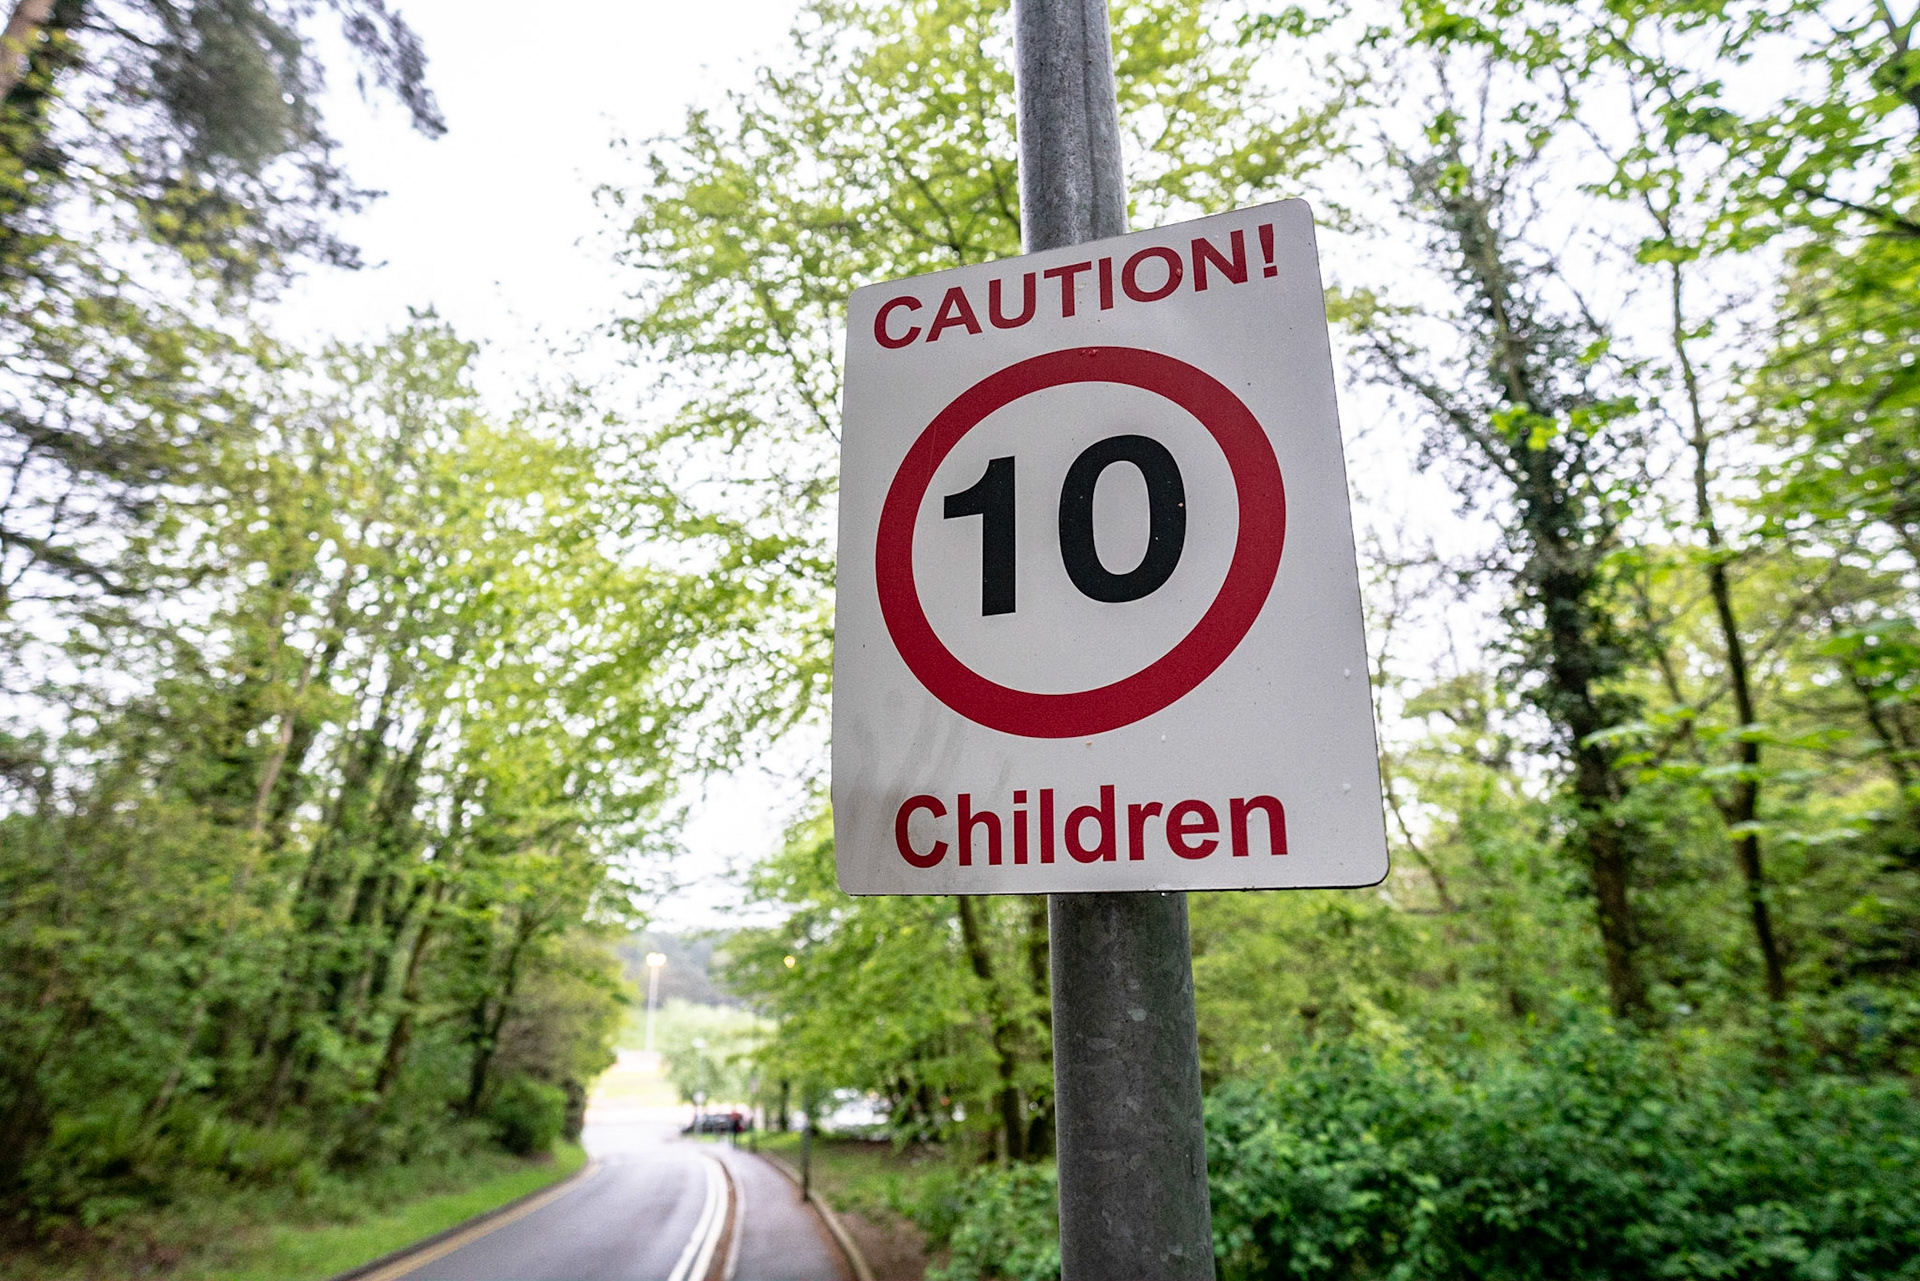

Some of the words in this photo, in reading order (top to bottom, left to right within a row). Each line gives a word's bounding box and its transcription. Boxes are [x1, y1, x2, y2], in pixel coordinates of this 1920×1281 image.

[874, 223, 1278, 349] CAUTION!
[943, 434, 1187, 617] 10
[894, 784, 1288, 869] Children
